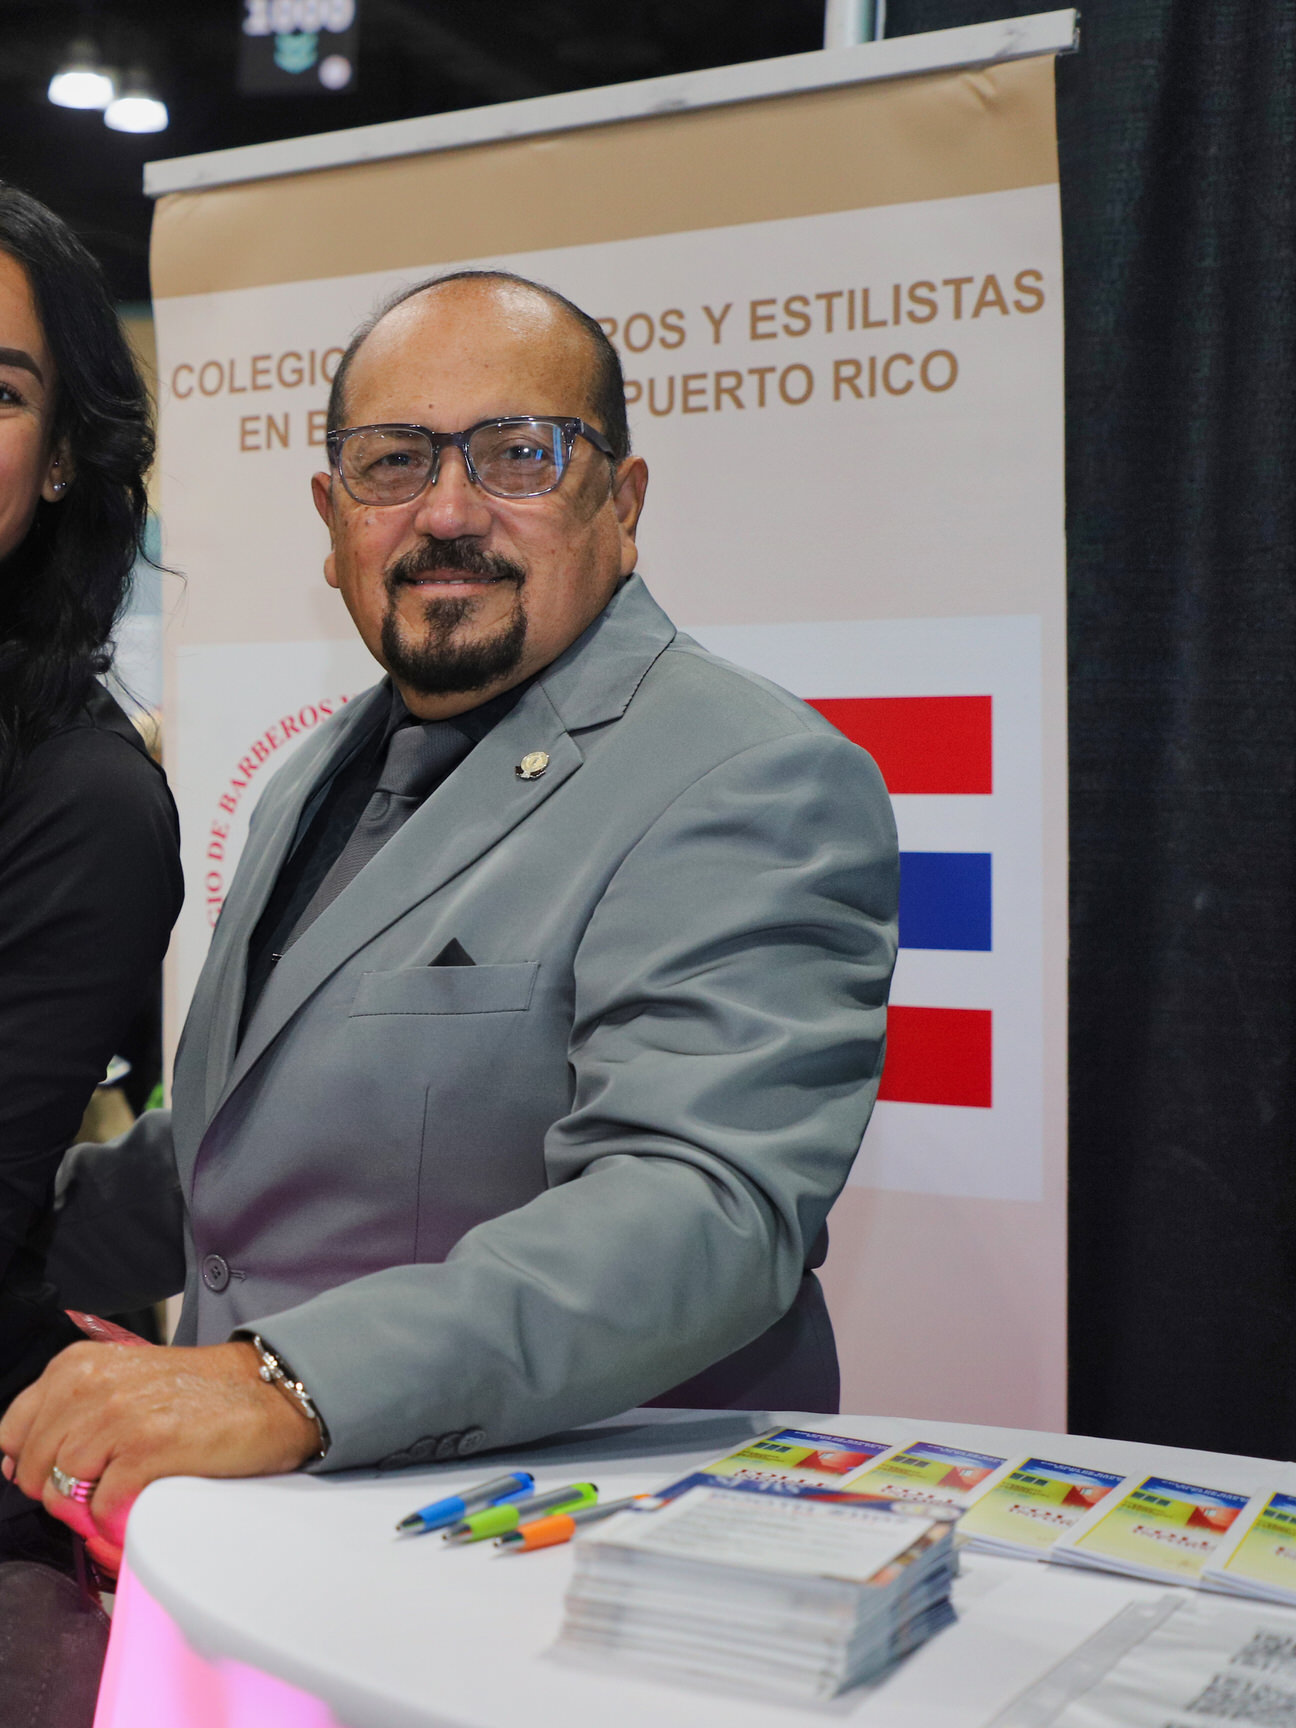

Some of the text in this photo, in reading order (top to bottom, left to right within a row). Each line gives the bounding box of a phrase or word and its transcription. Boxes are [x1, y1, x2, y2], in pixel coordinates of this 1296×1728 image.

[172, 347, 347, 400] COLEGIO
[702, 303, 733, 345] Y
[749, 268, 1046, 341] ESTILISTAS
[240, 412, 290, 453] EN
[622, 363, 815, 417] PUERTO
[833, 349, 960, 401] RICO
[218, 697, 334, 816] BARBEROS
[207, 819, 230, 861] DE
